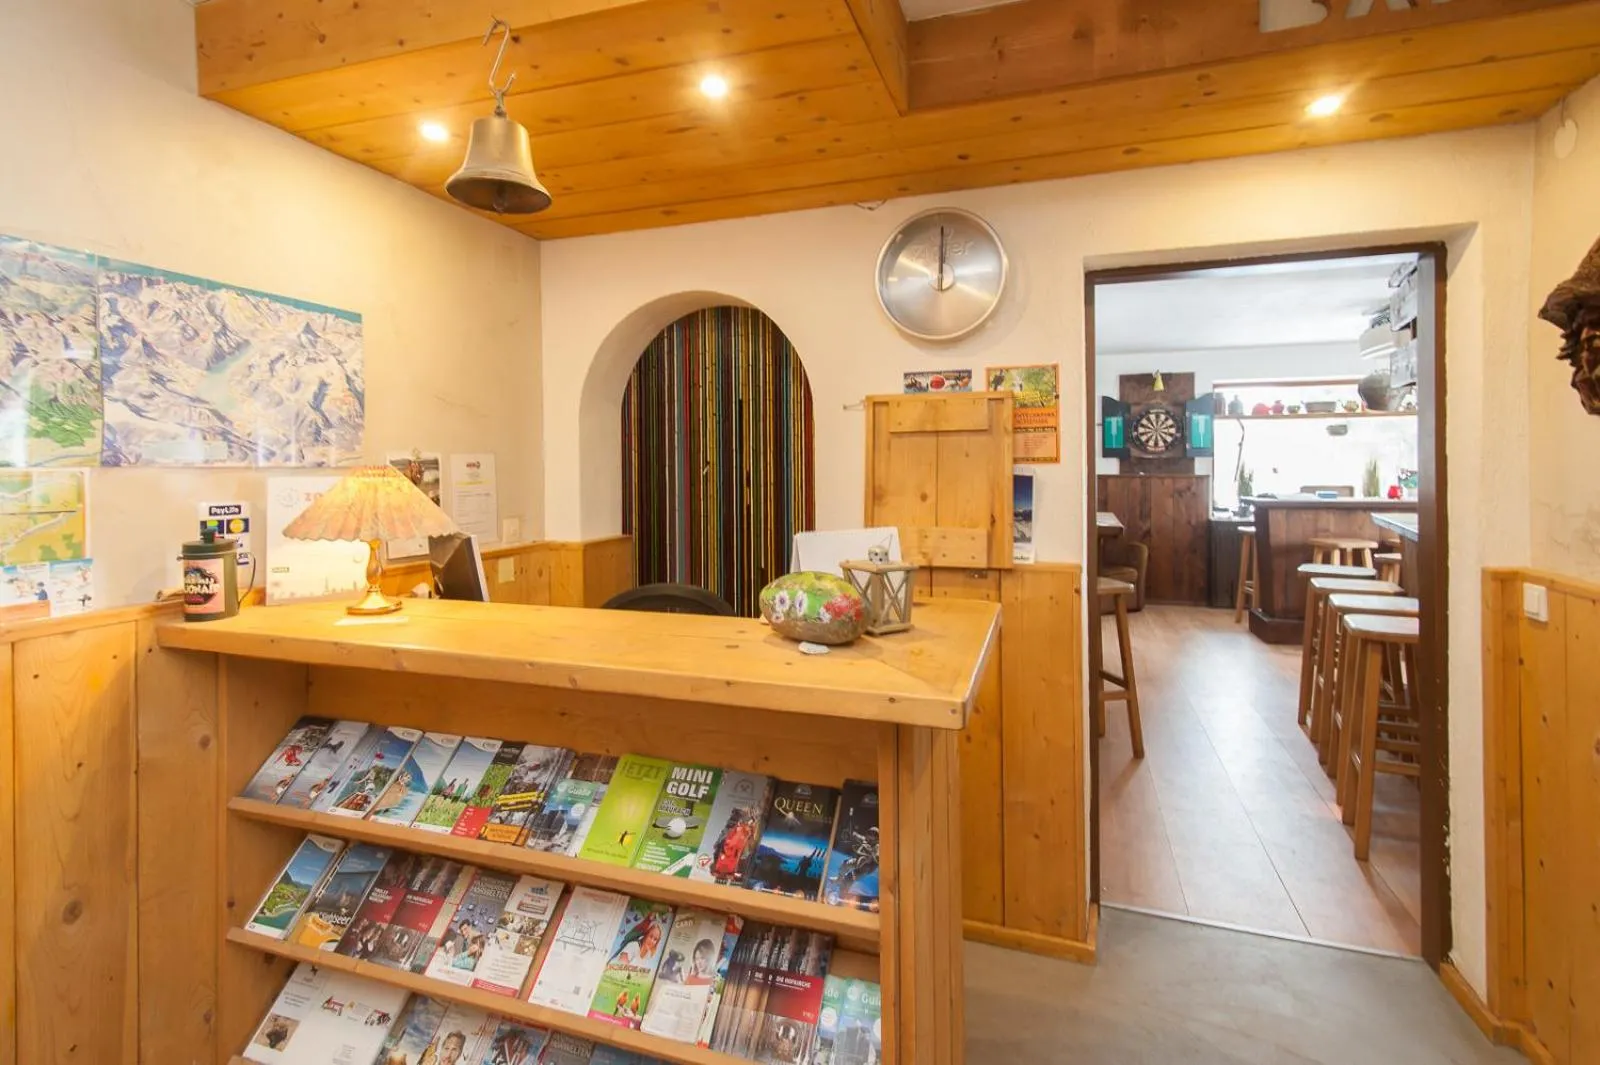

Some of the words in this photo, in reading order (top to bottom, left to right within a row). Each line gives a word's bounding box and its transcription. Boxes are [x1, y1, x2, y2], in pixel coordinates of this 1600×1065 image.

[210, 506, 240, 515] PayLife
[671, 766, 714, 784] MINI
[666, 781, 710, 799] GOLF
[774, 796, 824, 816] QUEEN
